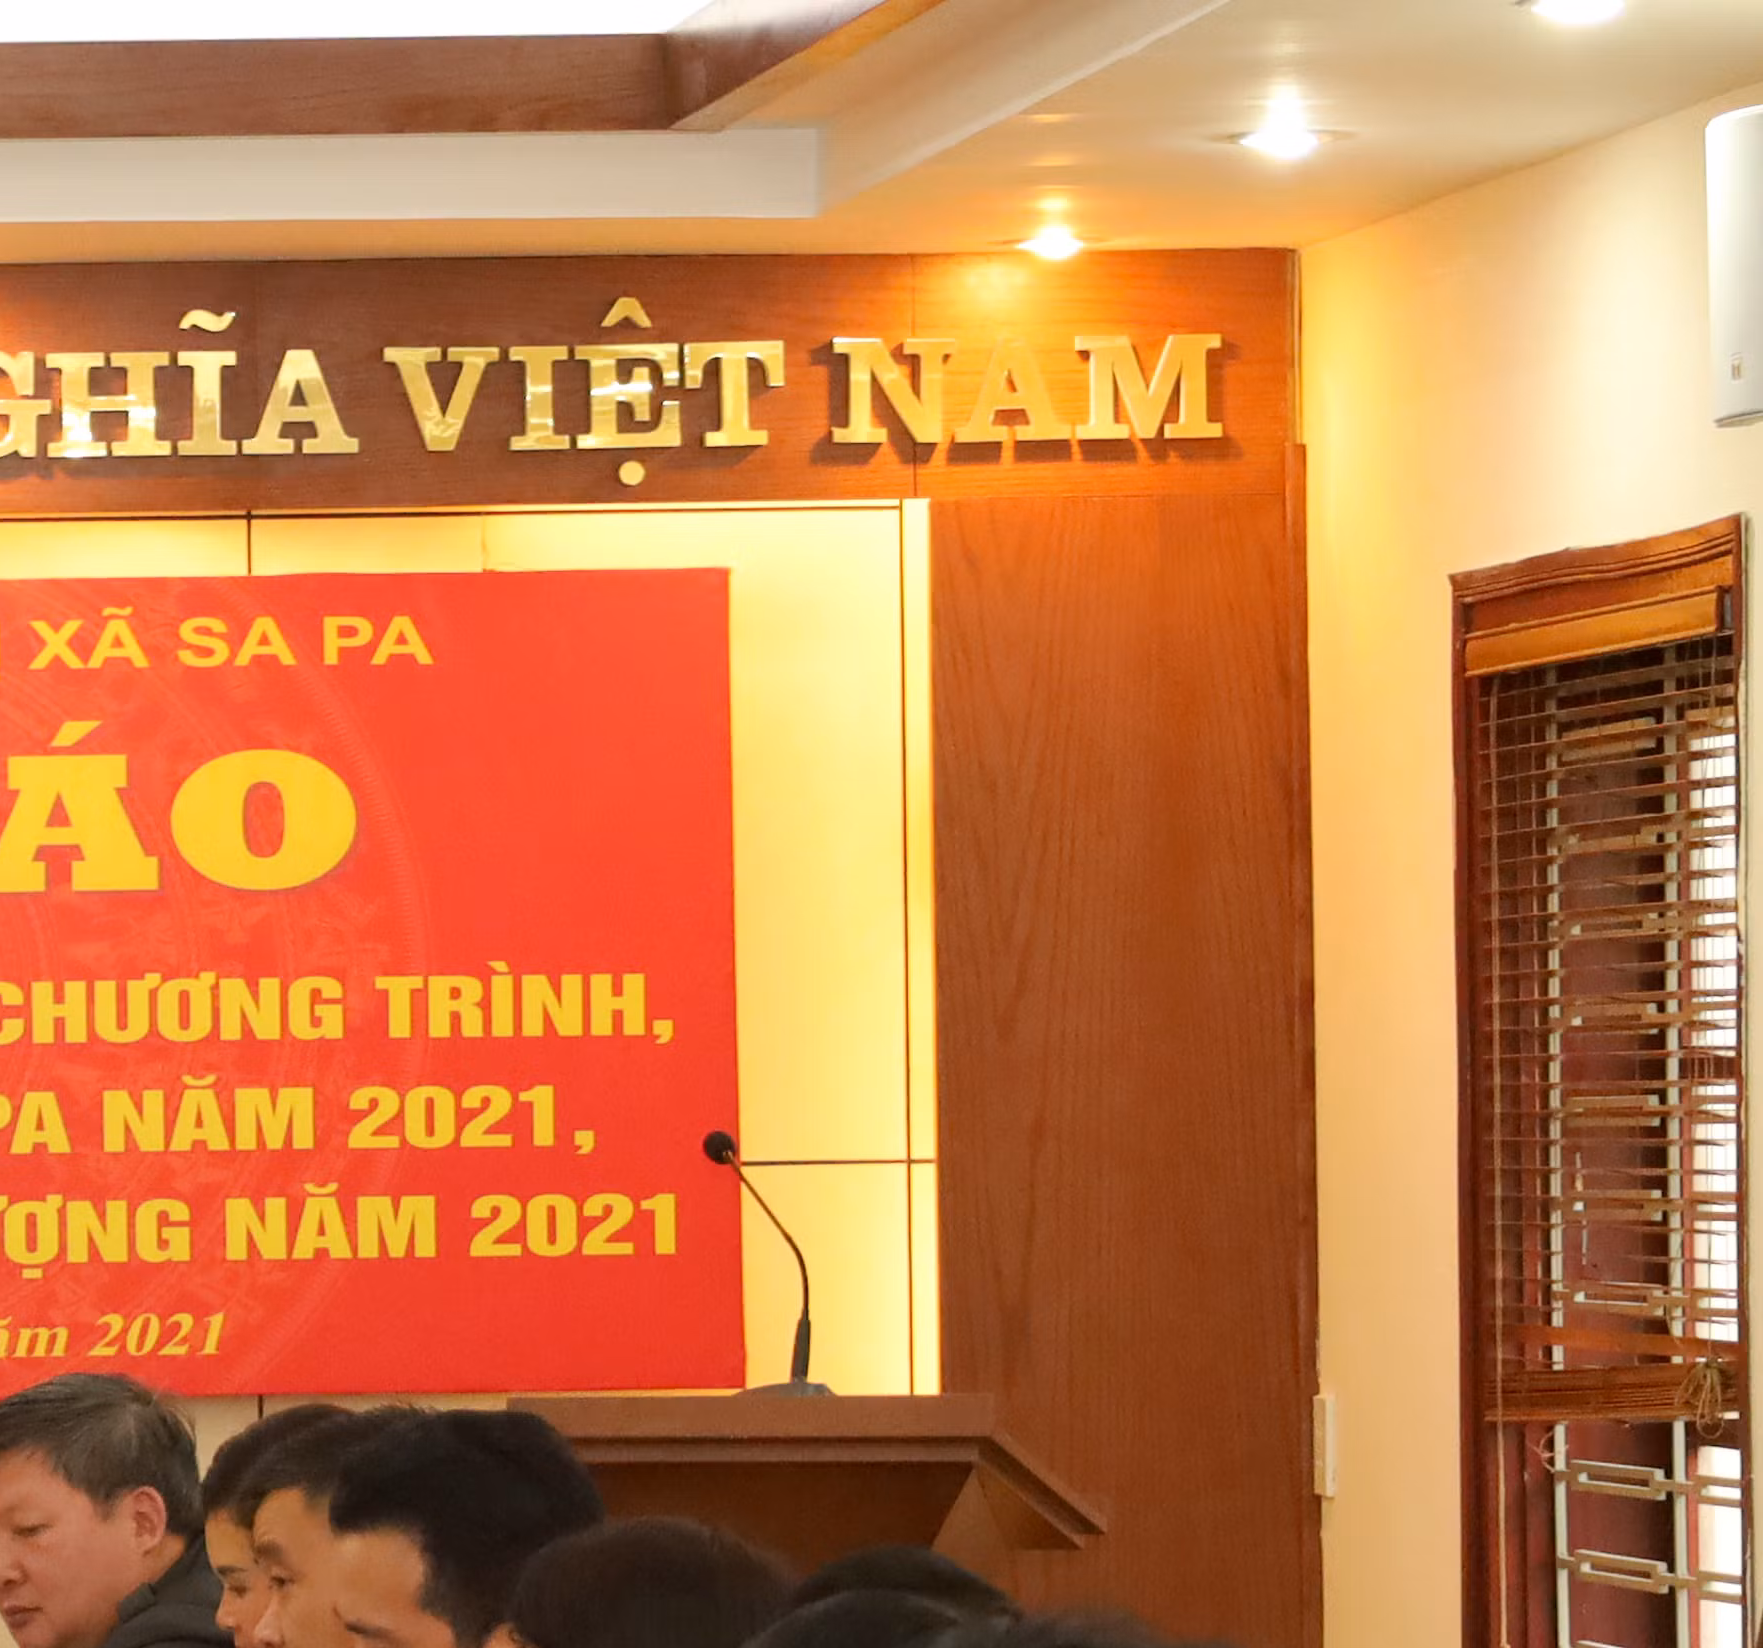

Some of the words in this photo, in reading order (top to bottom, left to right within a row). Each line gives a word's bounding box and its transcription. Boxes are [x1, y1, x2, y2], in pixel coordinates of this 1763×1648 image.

[383, 297, 785, 487] VIỆT
[829, 333, 1223, 445] NAM
[28, 606, 150, 670] XÃ
[177, 616, 297, 668] SA
[323, 615, 433, 665] PA
[374, 961, 675, 1044] TRÌNH,
[102, 1075, 315, 1153] NĂM
[225, 1183, 436, 1261] NĂM
[470, 1193, 676, 1257] 2021
[89, 1312, 226, 1357] 2021
